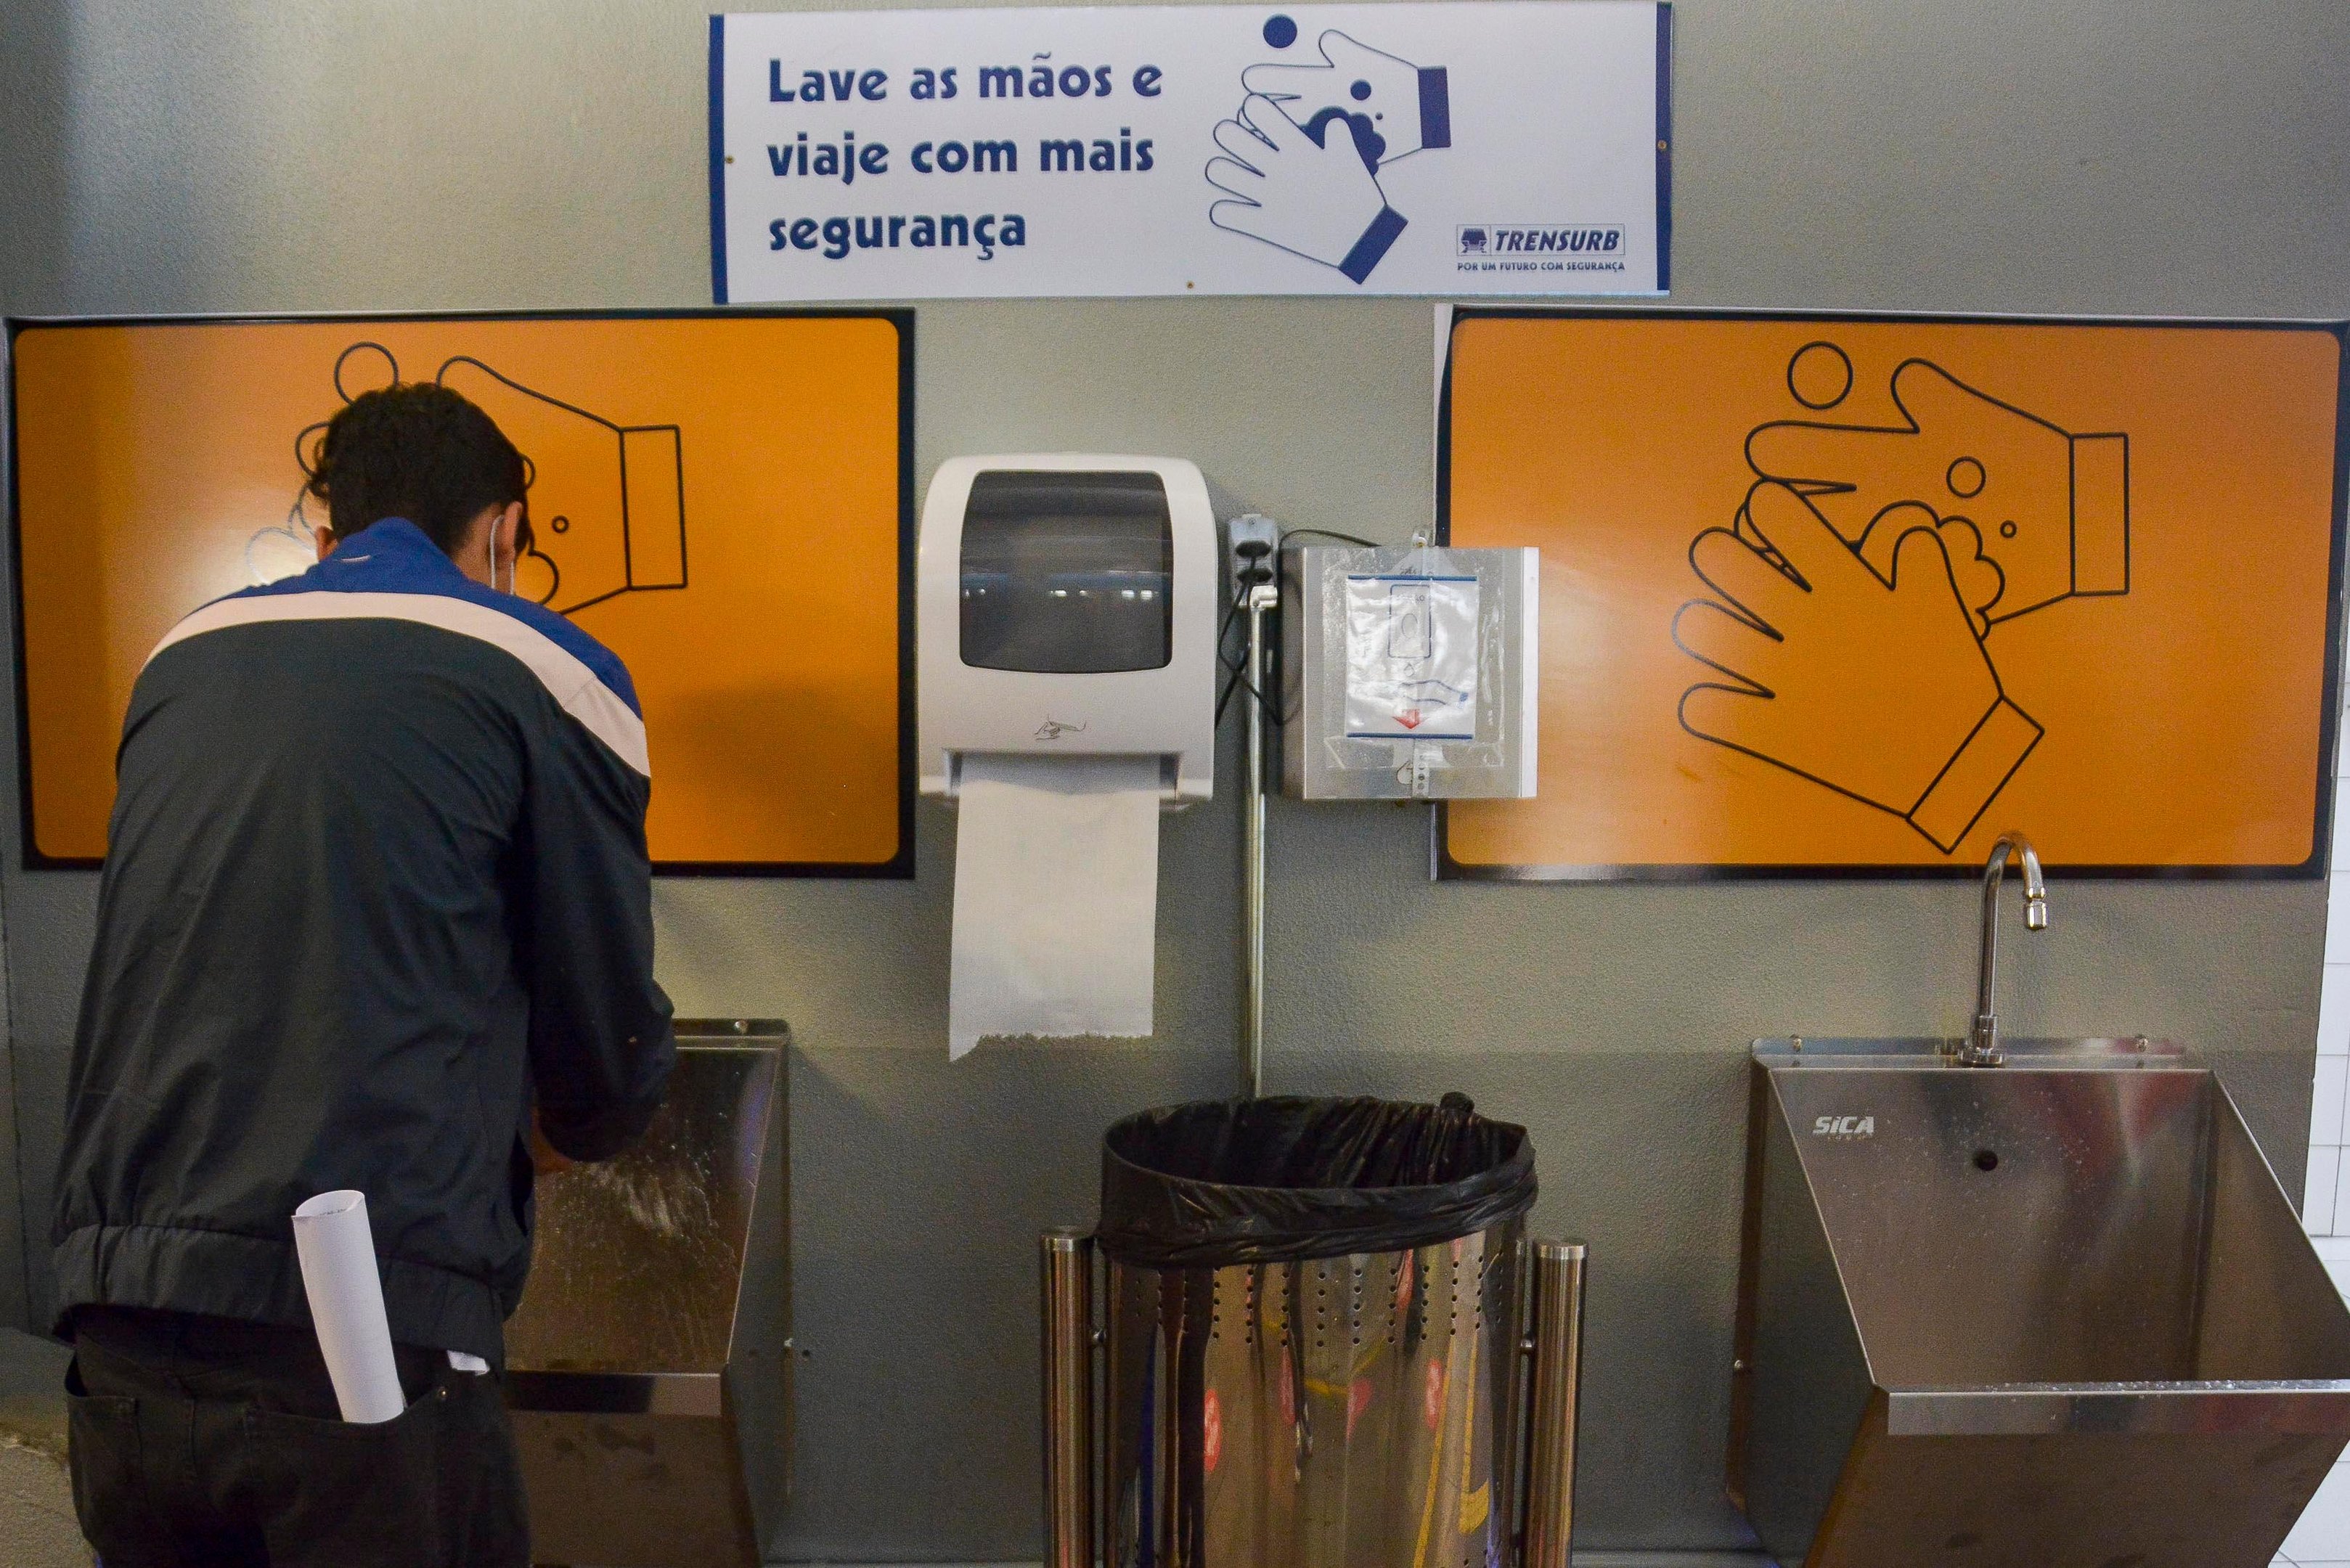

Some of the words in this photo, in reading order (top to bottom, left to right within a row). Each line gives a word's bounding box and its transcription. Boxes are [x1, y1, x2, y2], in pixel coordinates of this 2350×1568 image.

[769, 58, 889, 102] Lave
[909, 67, 958, 100] as
[979, 52, 1113, 98] mãos
[1132, 65, 1163, 97] e
[766, 131, 890, 186] viaje
[910, 139, 1019, 174] com
[1039, 126, 1154, 172] mais
[768, 213, 1027, 261] segurança
[1495, 229, 1620, 252] TRENSURB
[1457, 262, 1478, 271] POR
[1481, 262, 1496, 271] UM
[1499, 262, 1538, 271] FUTURO
[1541, 262, 1564, 271] COM
[1567, 261, 1625, 273] SEGURANÇA
